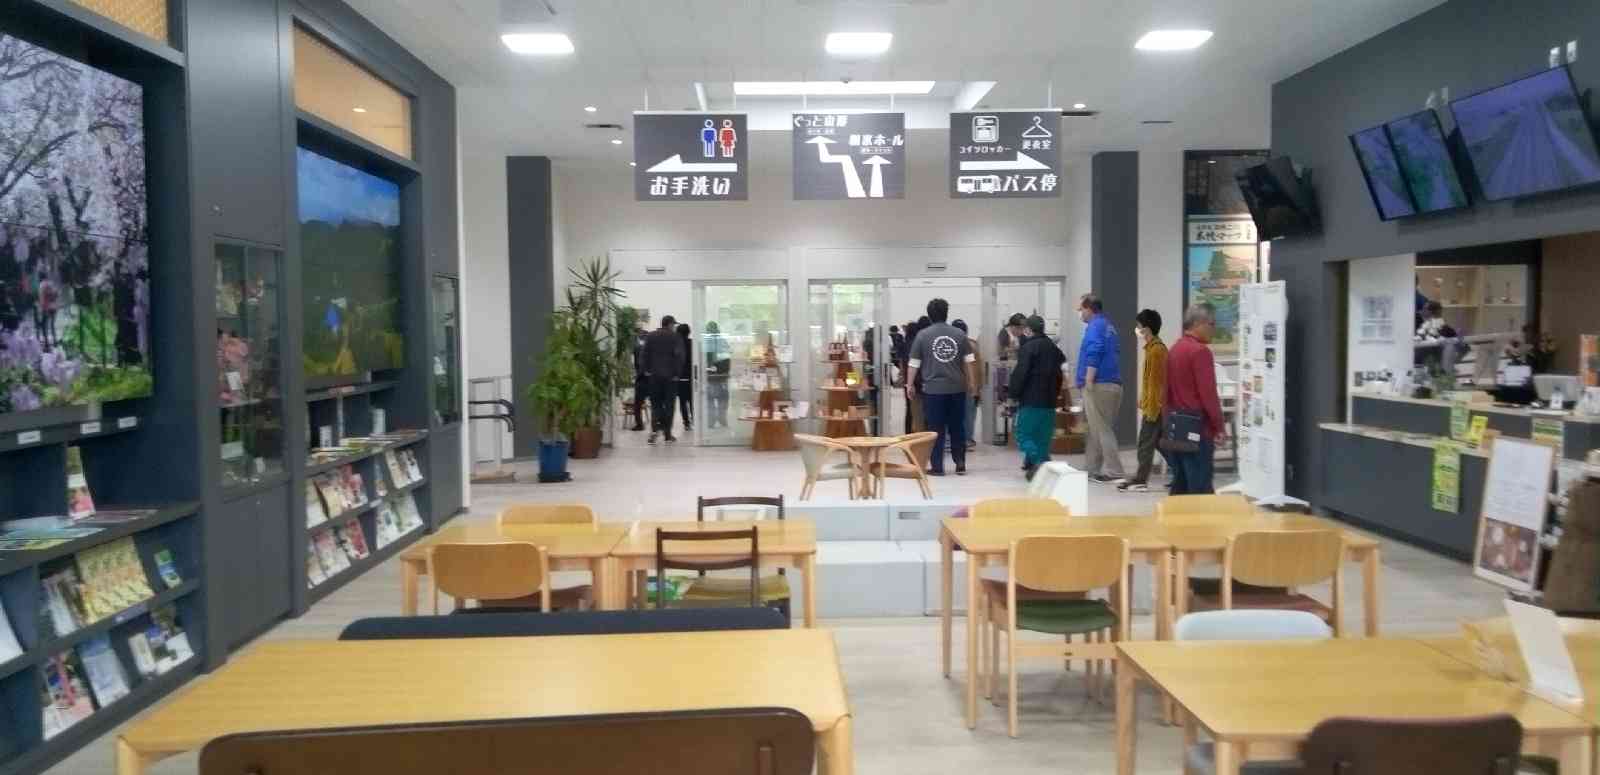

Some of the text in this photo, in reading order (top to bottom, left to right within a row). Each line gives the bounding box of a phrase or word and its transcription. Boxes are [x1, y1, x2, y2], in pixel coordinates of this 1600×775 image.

[959, 145, 1012, 154] コインロッカー
[648, 175, 731, 195] お手洗い
[1003, 173, 1058, 192] バス停
